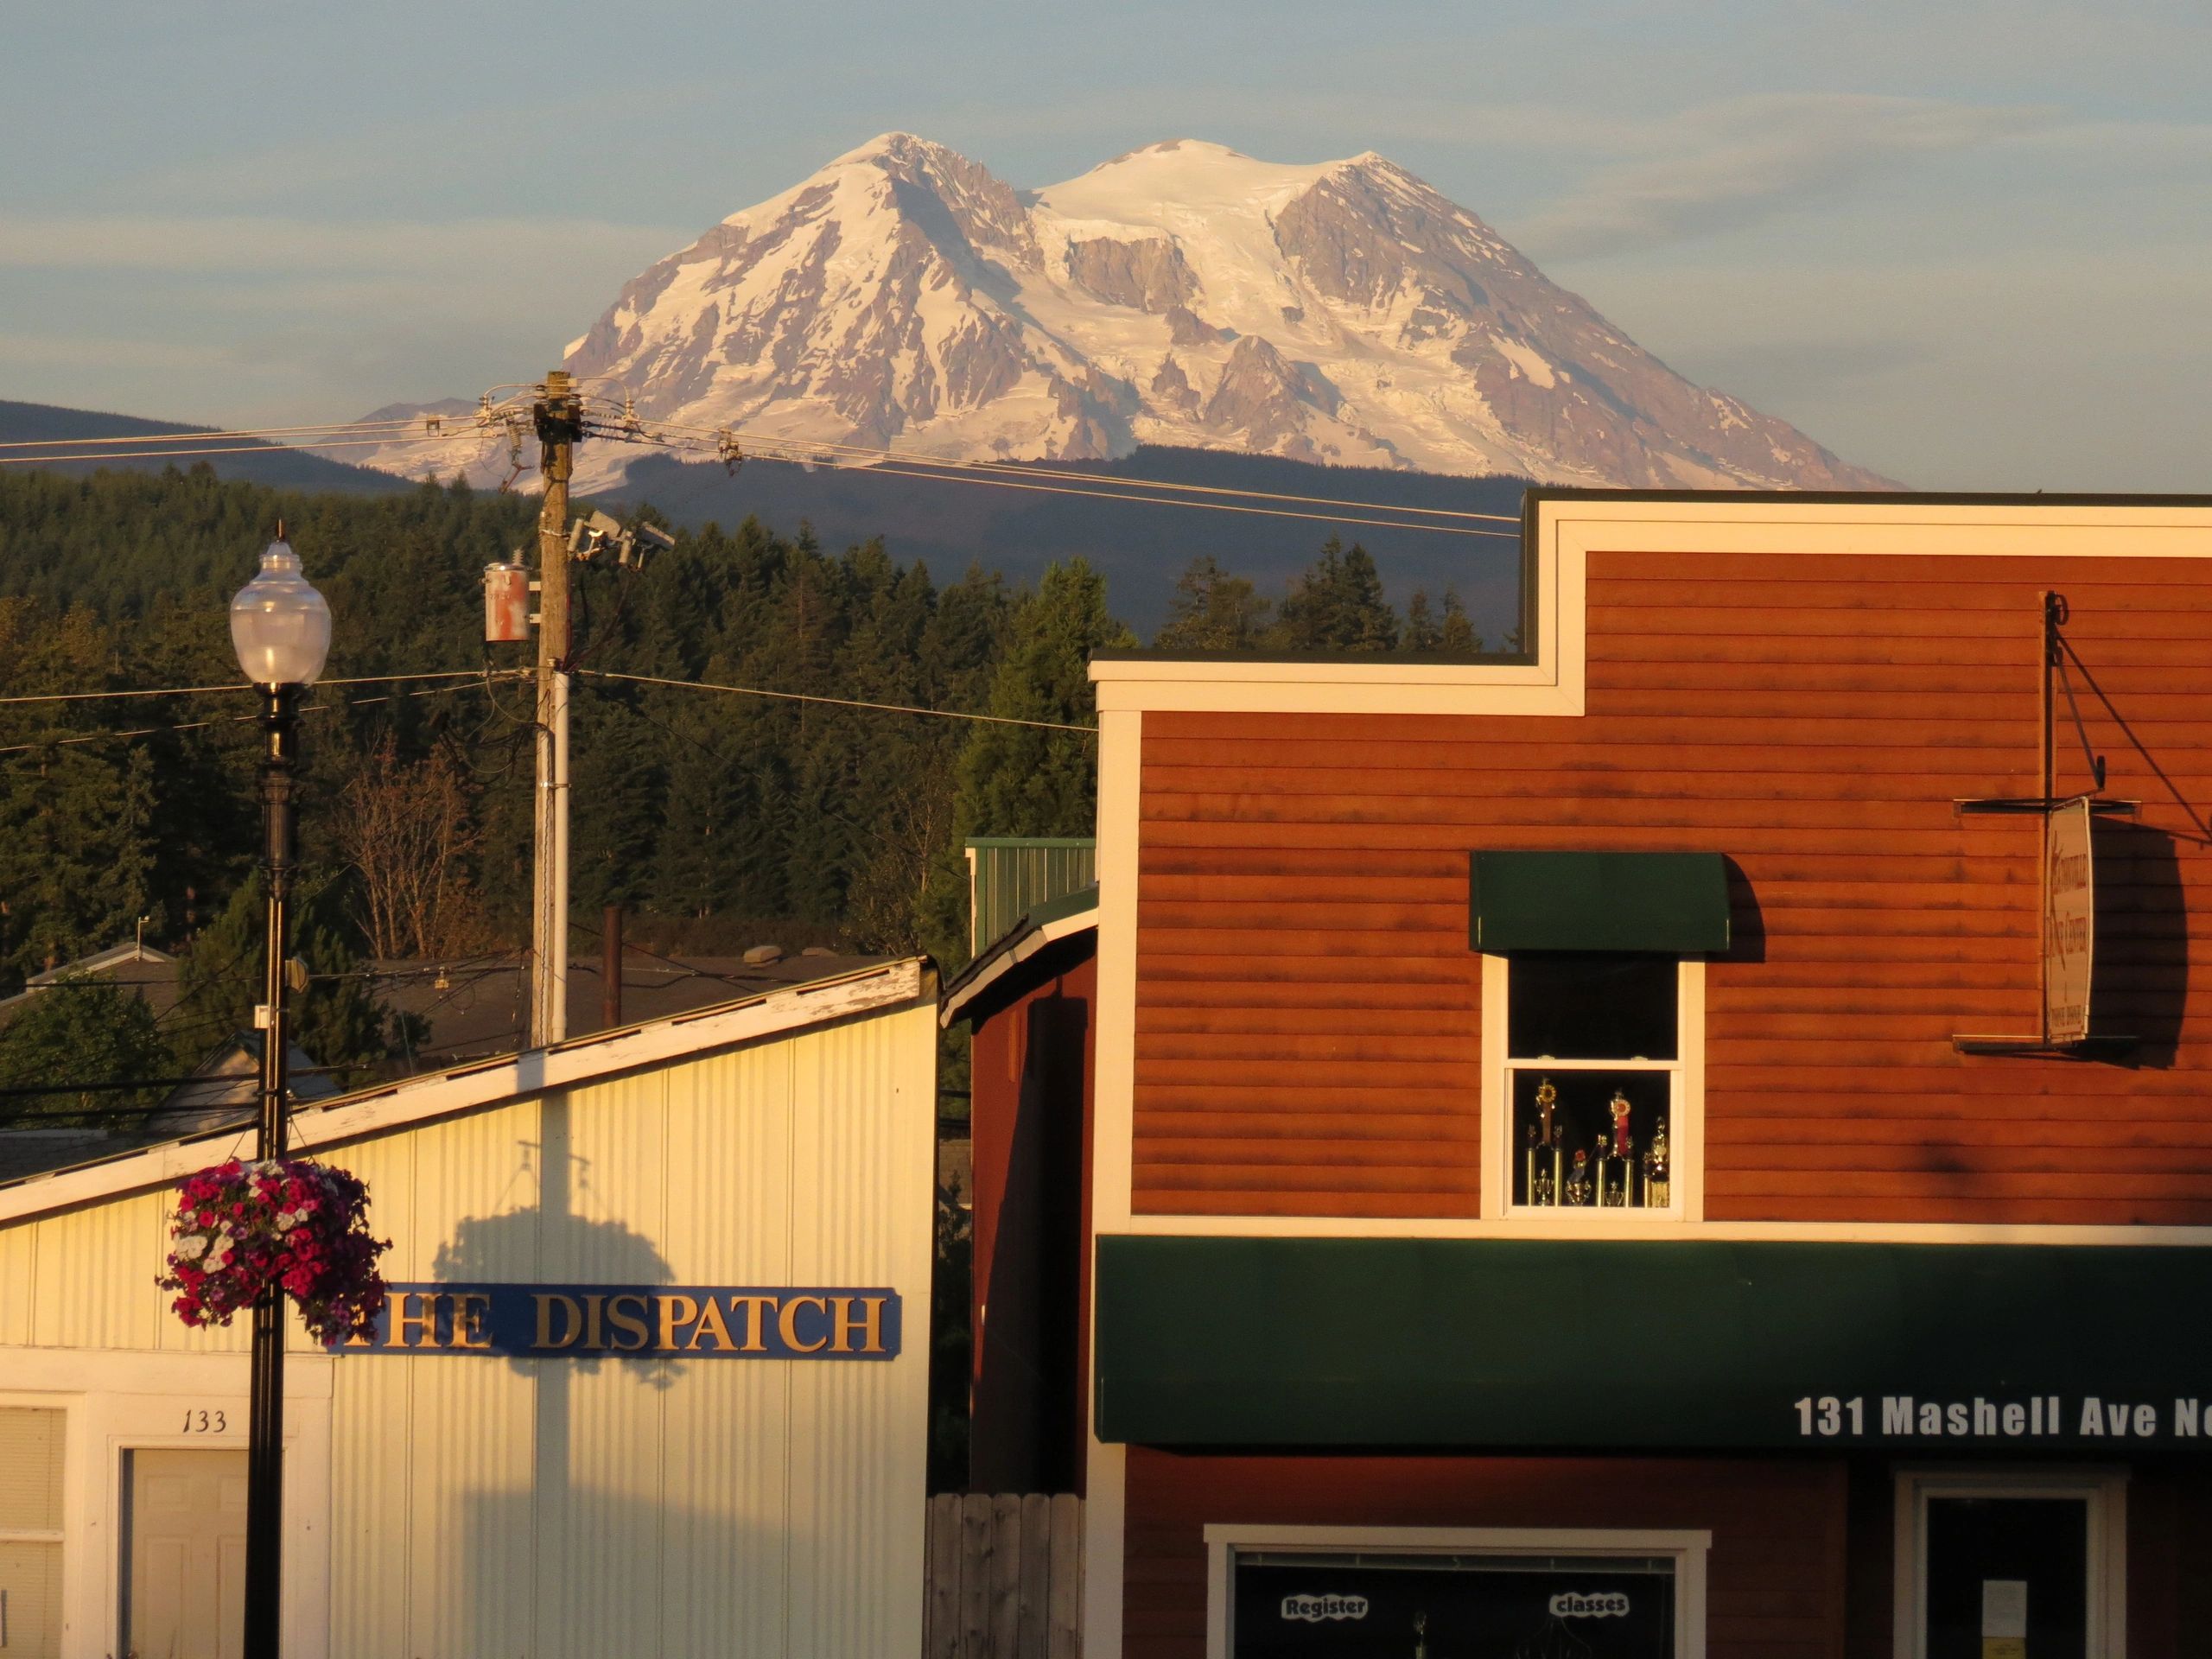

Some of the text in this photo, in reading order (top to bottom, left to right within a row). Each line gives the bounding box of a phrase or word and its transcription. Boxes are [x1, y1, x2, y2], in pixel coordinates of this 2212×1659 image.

[531, 1293, 888, 1353] DISPATCH
[182, 1409, 226, 1433] 133
[1794, 1396, 1863, 1436] 131
[1882, 1396, 2060, 1436] Mashell
[2080, 1397, 2156, 1437] Ave
[1286, 1597, 1366, 1618] Register
[1556, 1596, 1626, 1612] classes
